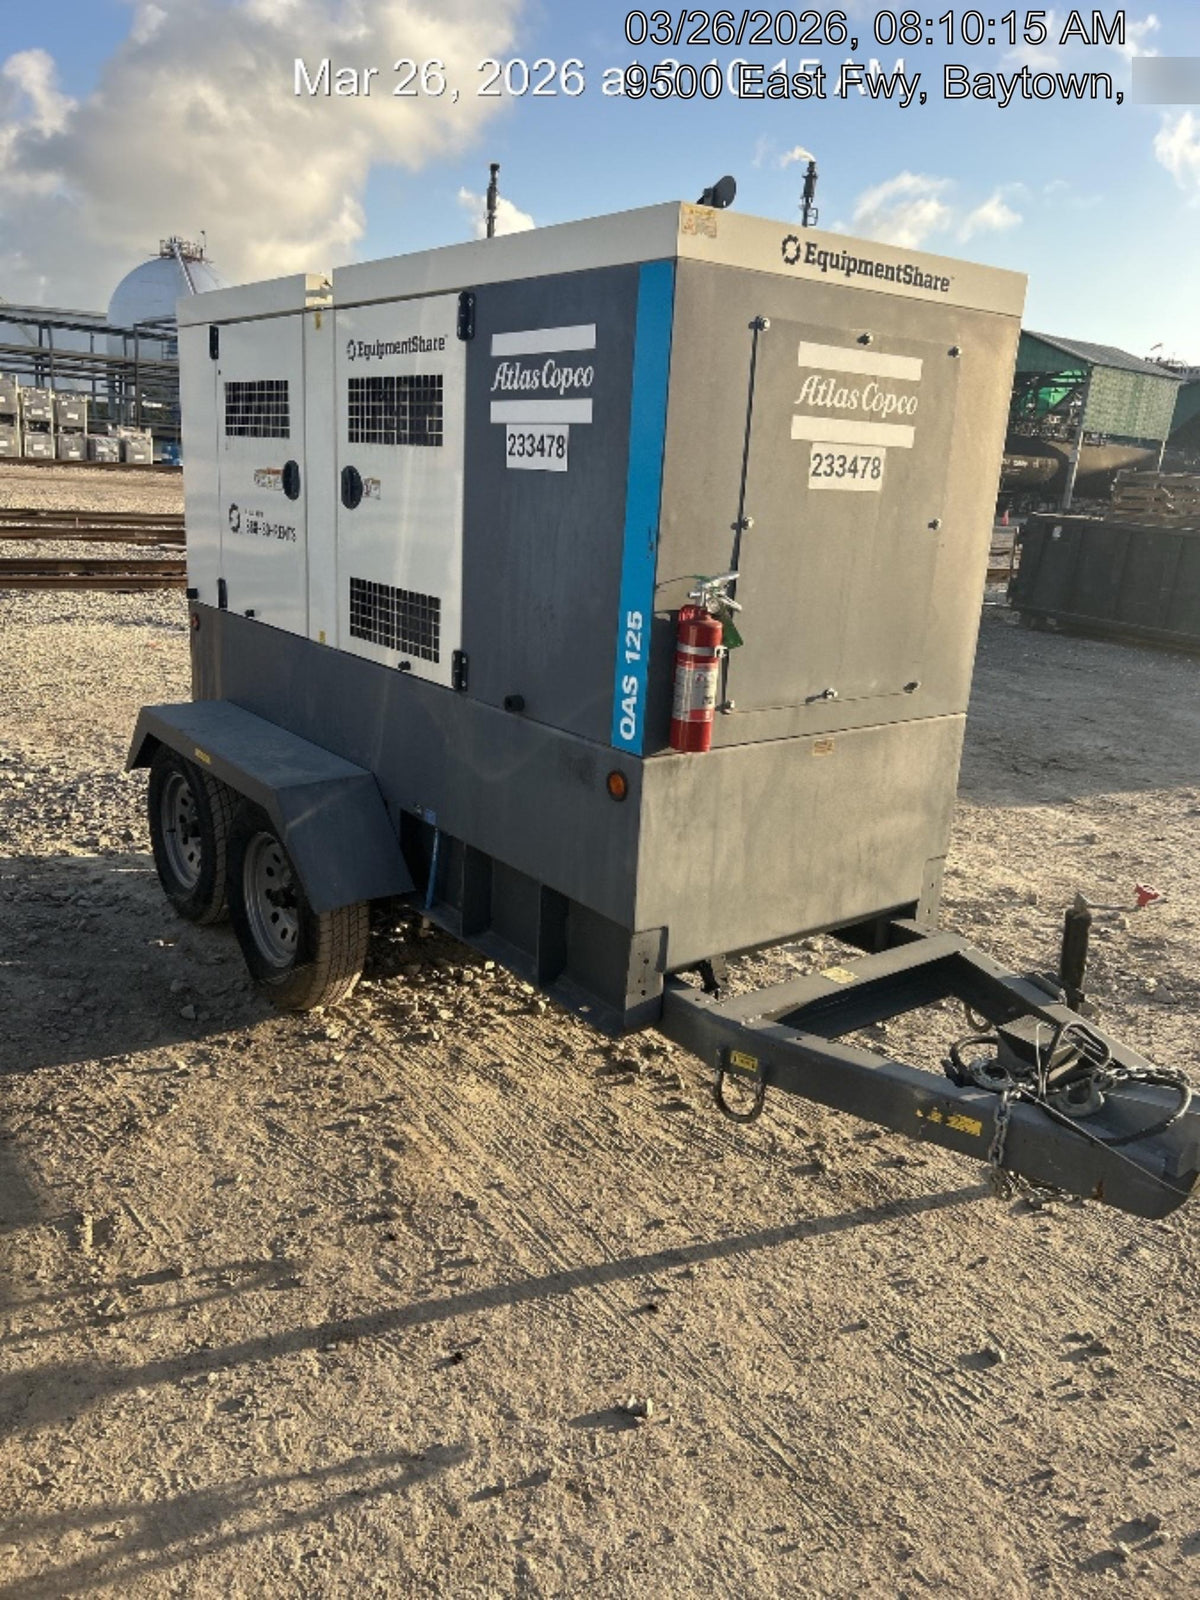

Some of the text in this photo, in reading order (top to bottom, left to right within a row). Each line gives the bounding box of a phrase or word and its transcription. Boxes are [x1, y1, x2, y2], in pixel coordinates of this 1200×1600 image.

[804, 241, 950, 292] EquipmentShare
[357, 335, 446, 360] EquipmentShare
[490, 359, 594, 395] Atlas Copco
[794, 375, 918, 418] Atlas Copco
[508, 433, 566, 459] 233478
[811, 452, 881, 480] 233478
[625, 610, 643, 664] 125
